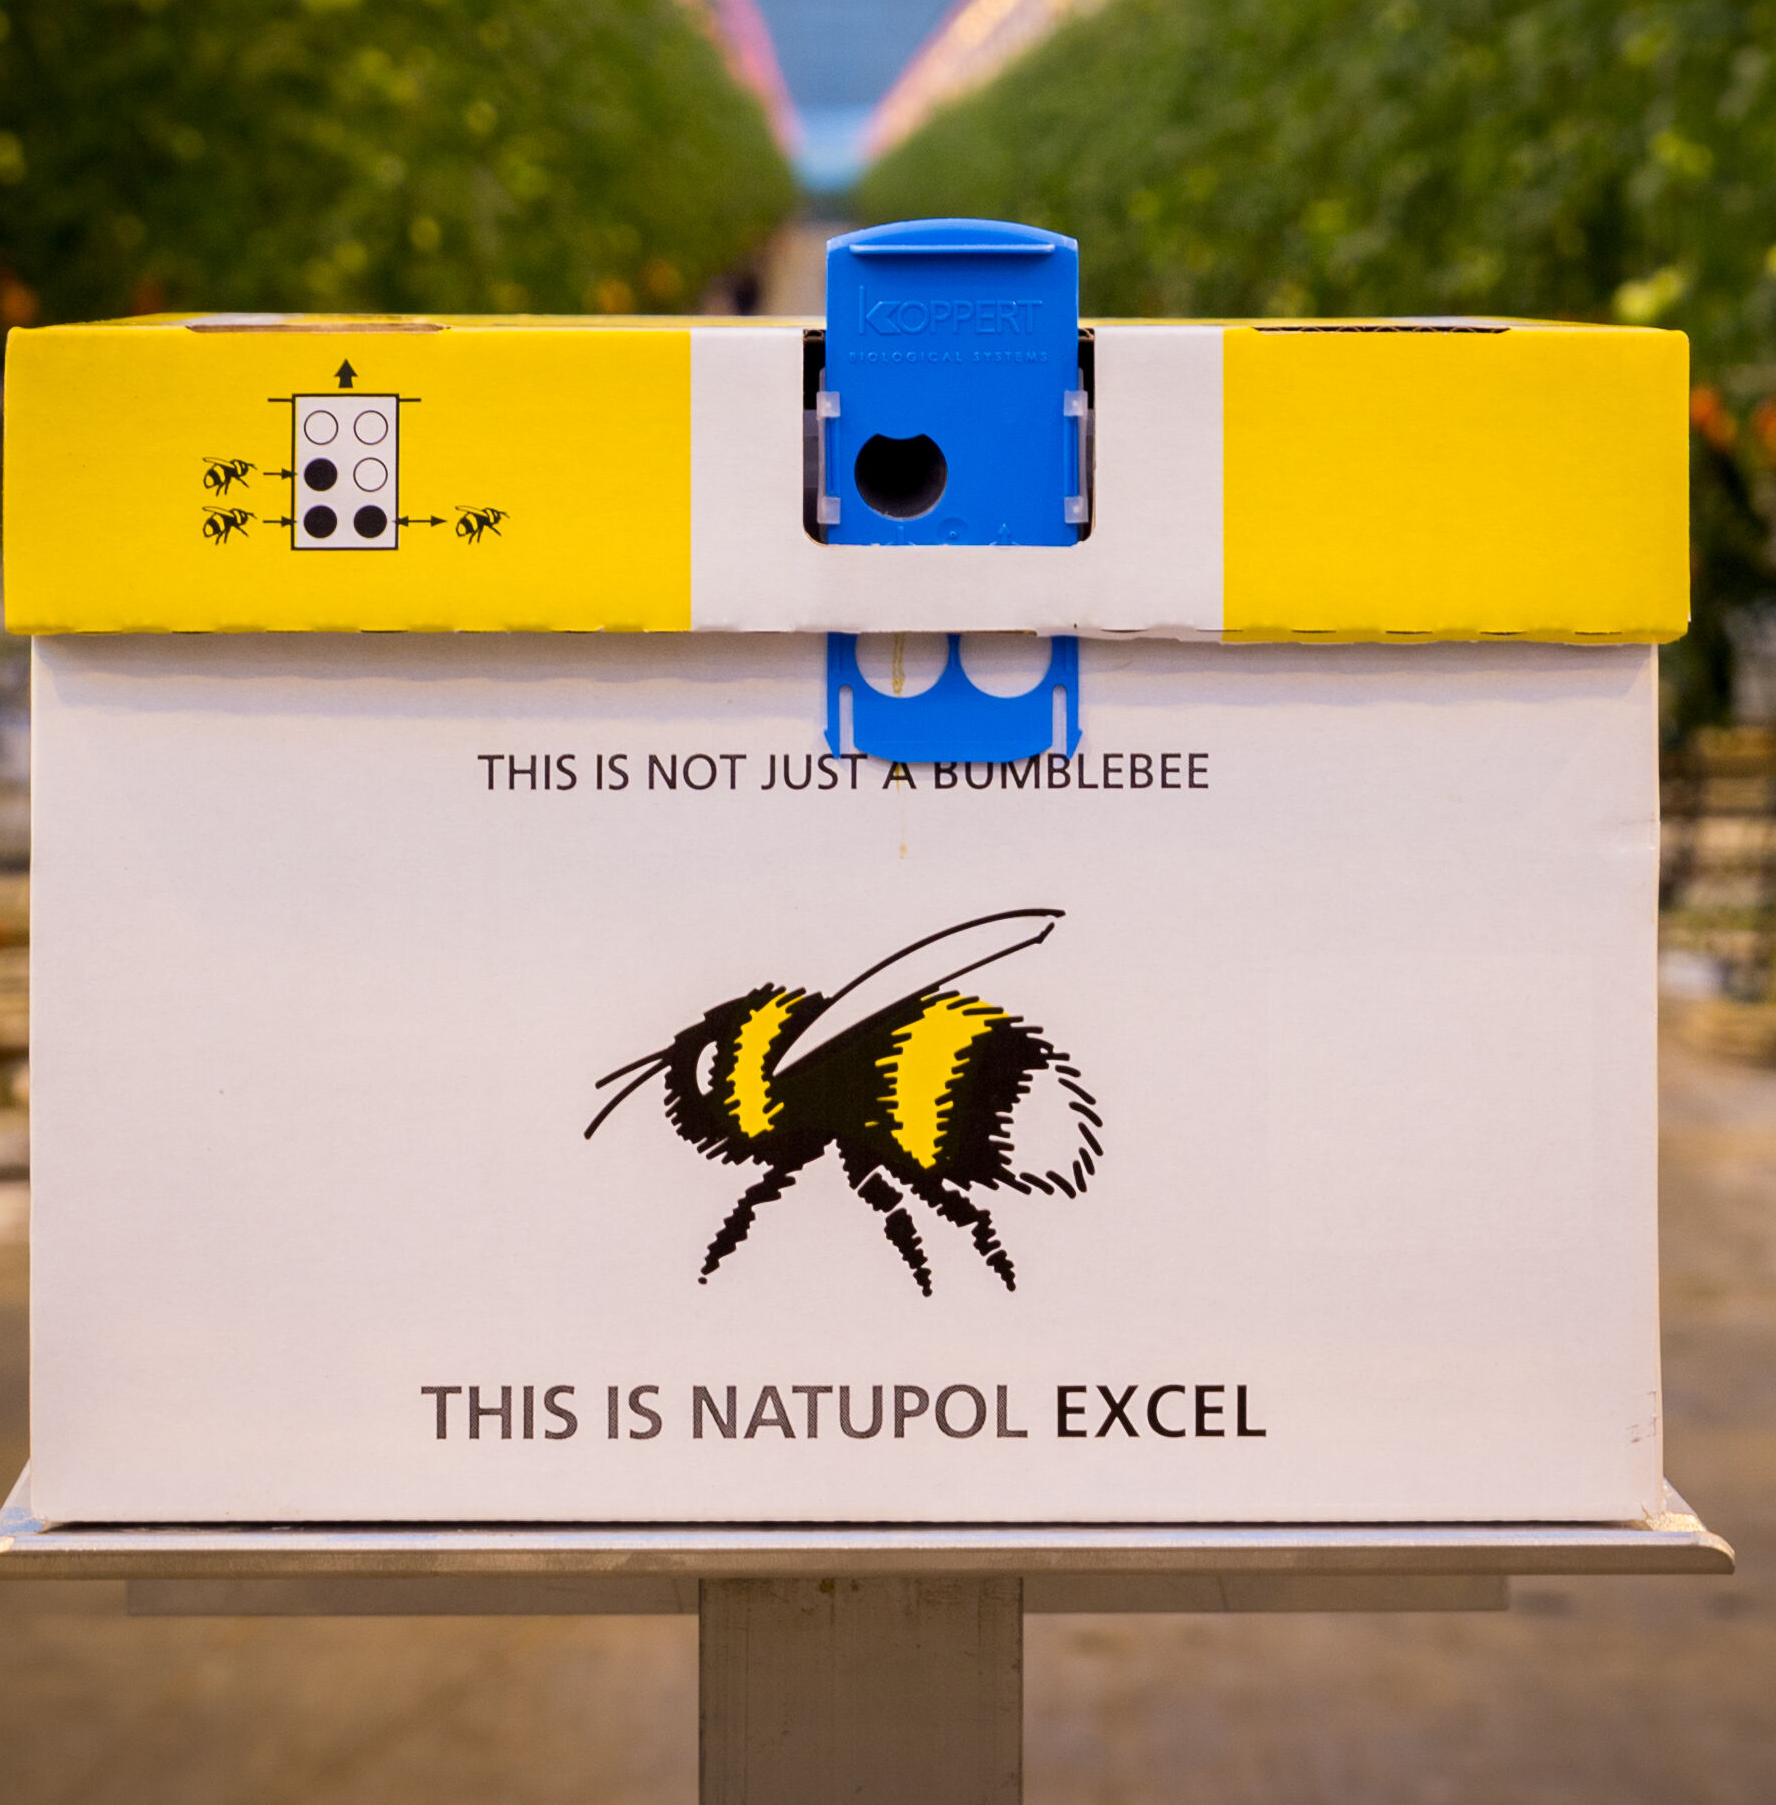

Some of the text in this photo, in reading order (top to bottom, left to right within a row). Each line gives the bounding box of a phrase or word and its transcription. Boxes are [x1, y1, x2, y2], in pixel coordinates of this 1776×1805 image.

[857, 284, 1044, 336] KOPPERT
[848, 350, 1050, 364] BIOLOGICAL SYSTEMS
[477, 753, 1210, 791] THIS IS NOT JUST A BUMBLEBEE
[420, 1384, 1267, 1440] THIS IS NATUPOL EXCEL
